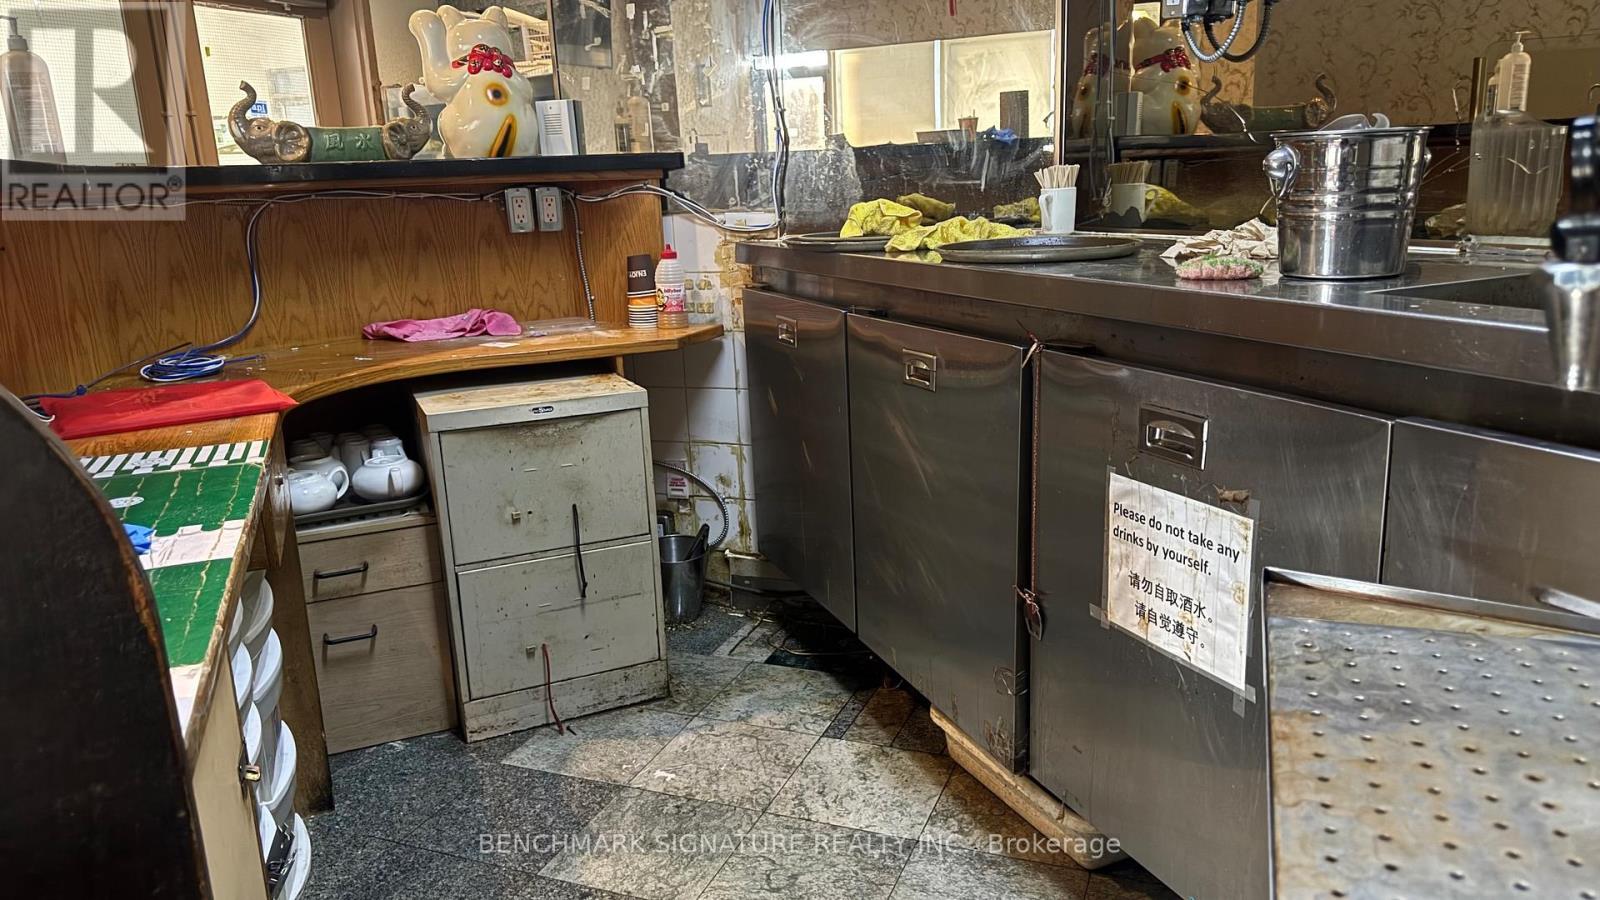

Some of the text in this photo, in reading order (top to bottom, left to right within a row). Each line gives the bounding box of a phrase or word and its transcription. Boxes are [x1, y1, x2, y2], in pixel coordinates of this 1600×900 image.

[629, 270, 647, 278] ENJOY
[1113, 502, 1241, 563] Please do not take any
[1113, 525, 1212, 576] drinks by yourself.
[1128, 570, 1213, 624] 请勿自取酒水。
[1134, 601, 1205, 649] 请自觉遵守。
